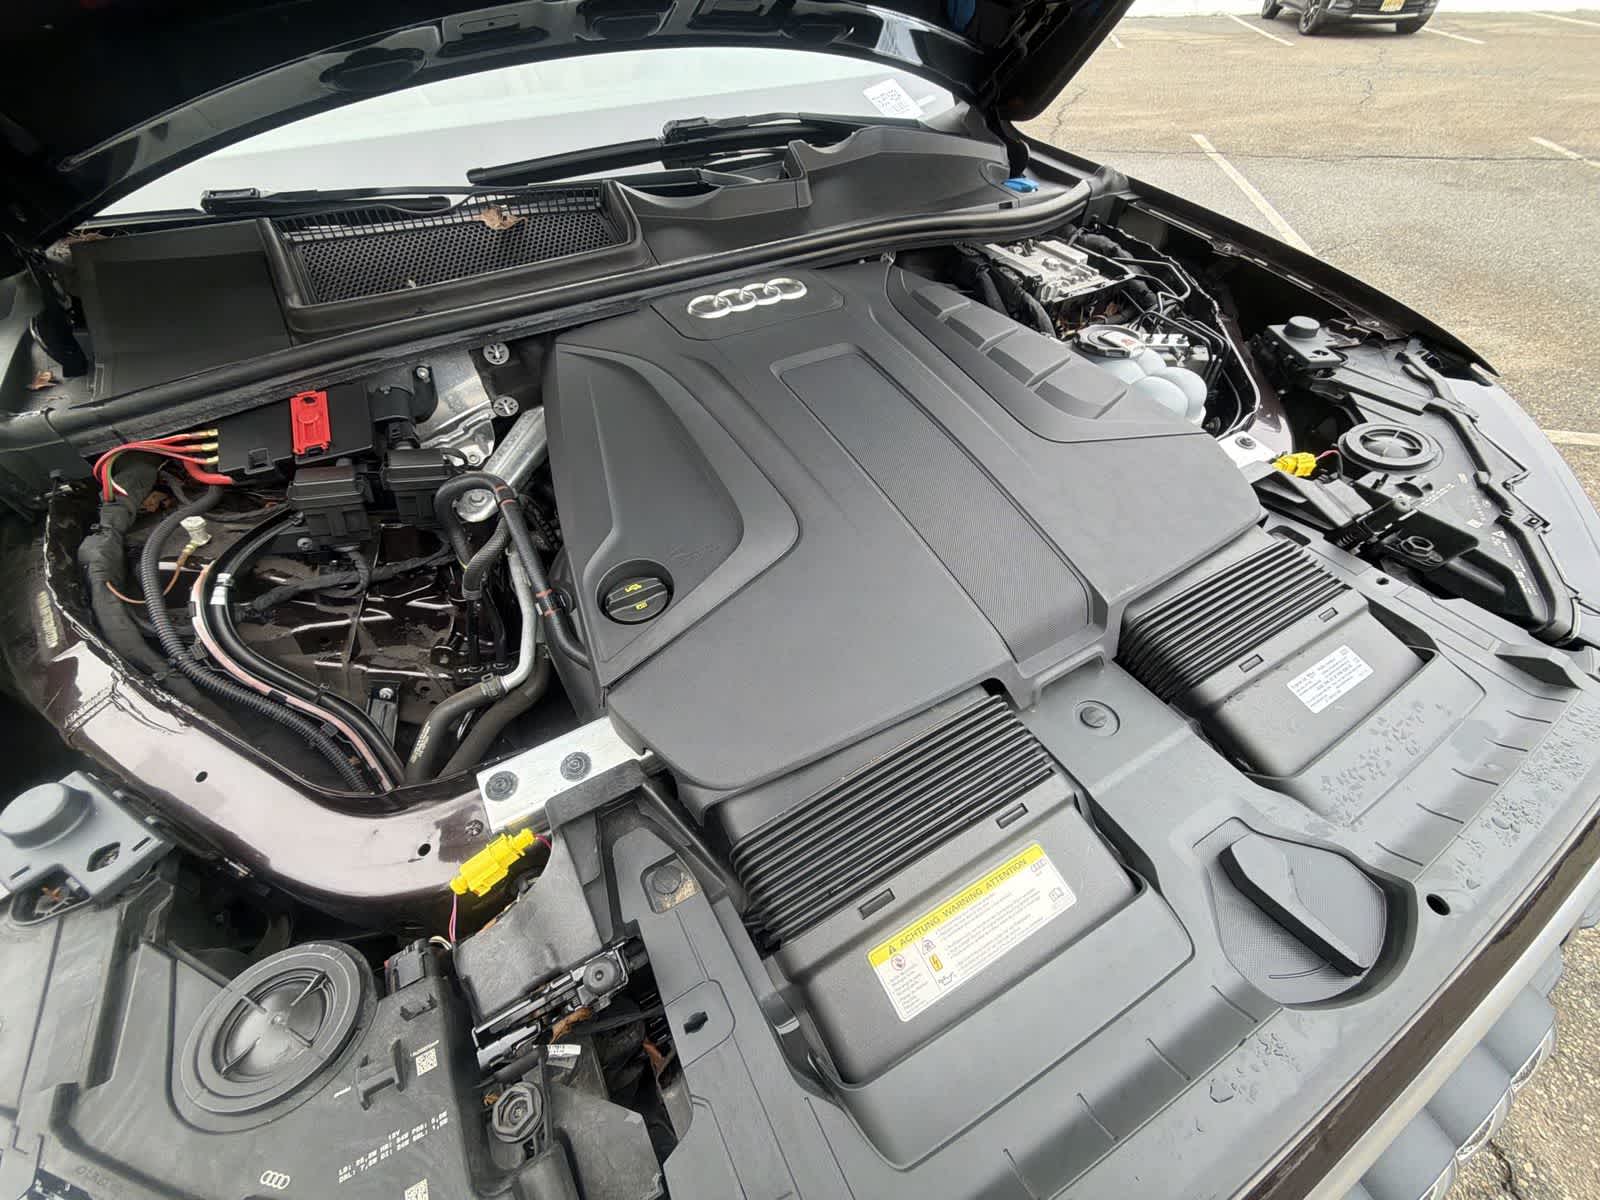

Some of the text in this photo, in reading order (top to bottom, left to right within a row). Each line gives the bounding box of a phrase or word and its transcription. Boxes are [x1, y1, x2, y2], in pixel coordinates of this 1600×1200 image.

[899, 916, 941, 947] ACHTUNG
[942, 888, 983, 917] WARNING
[985, 858, 1028, 890] ATTENTION
